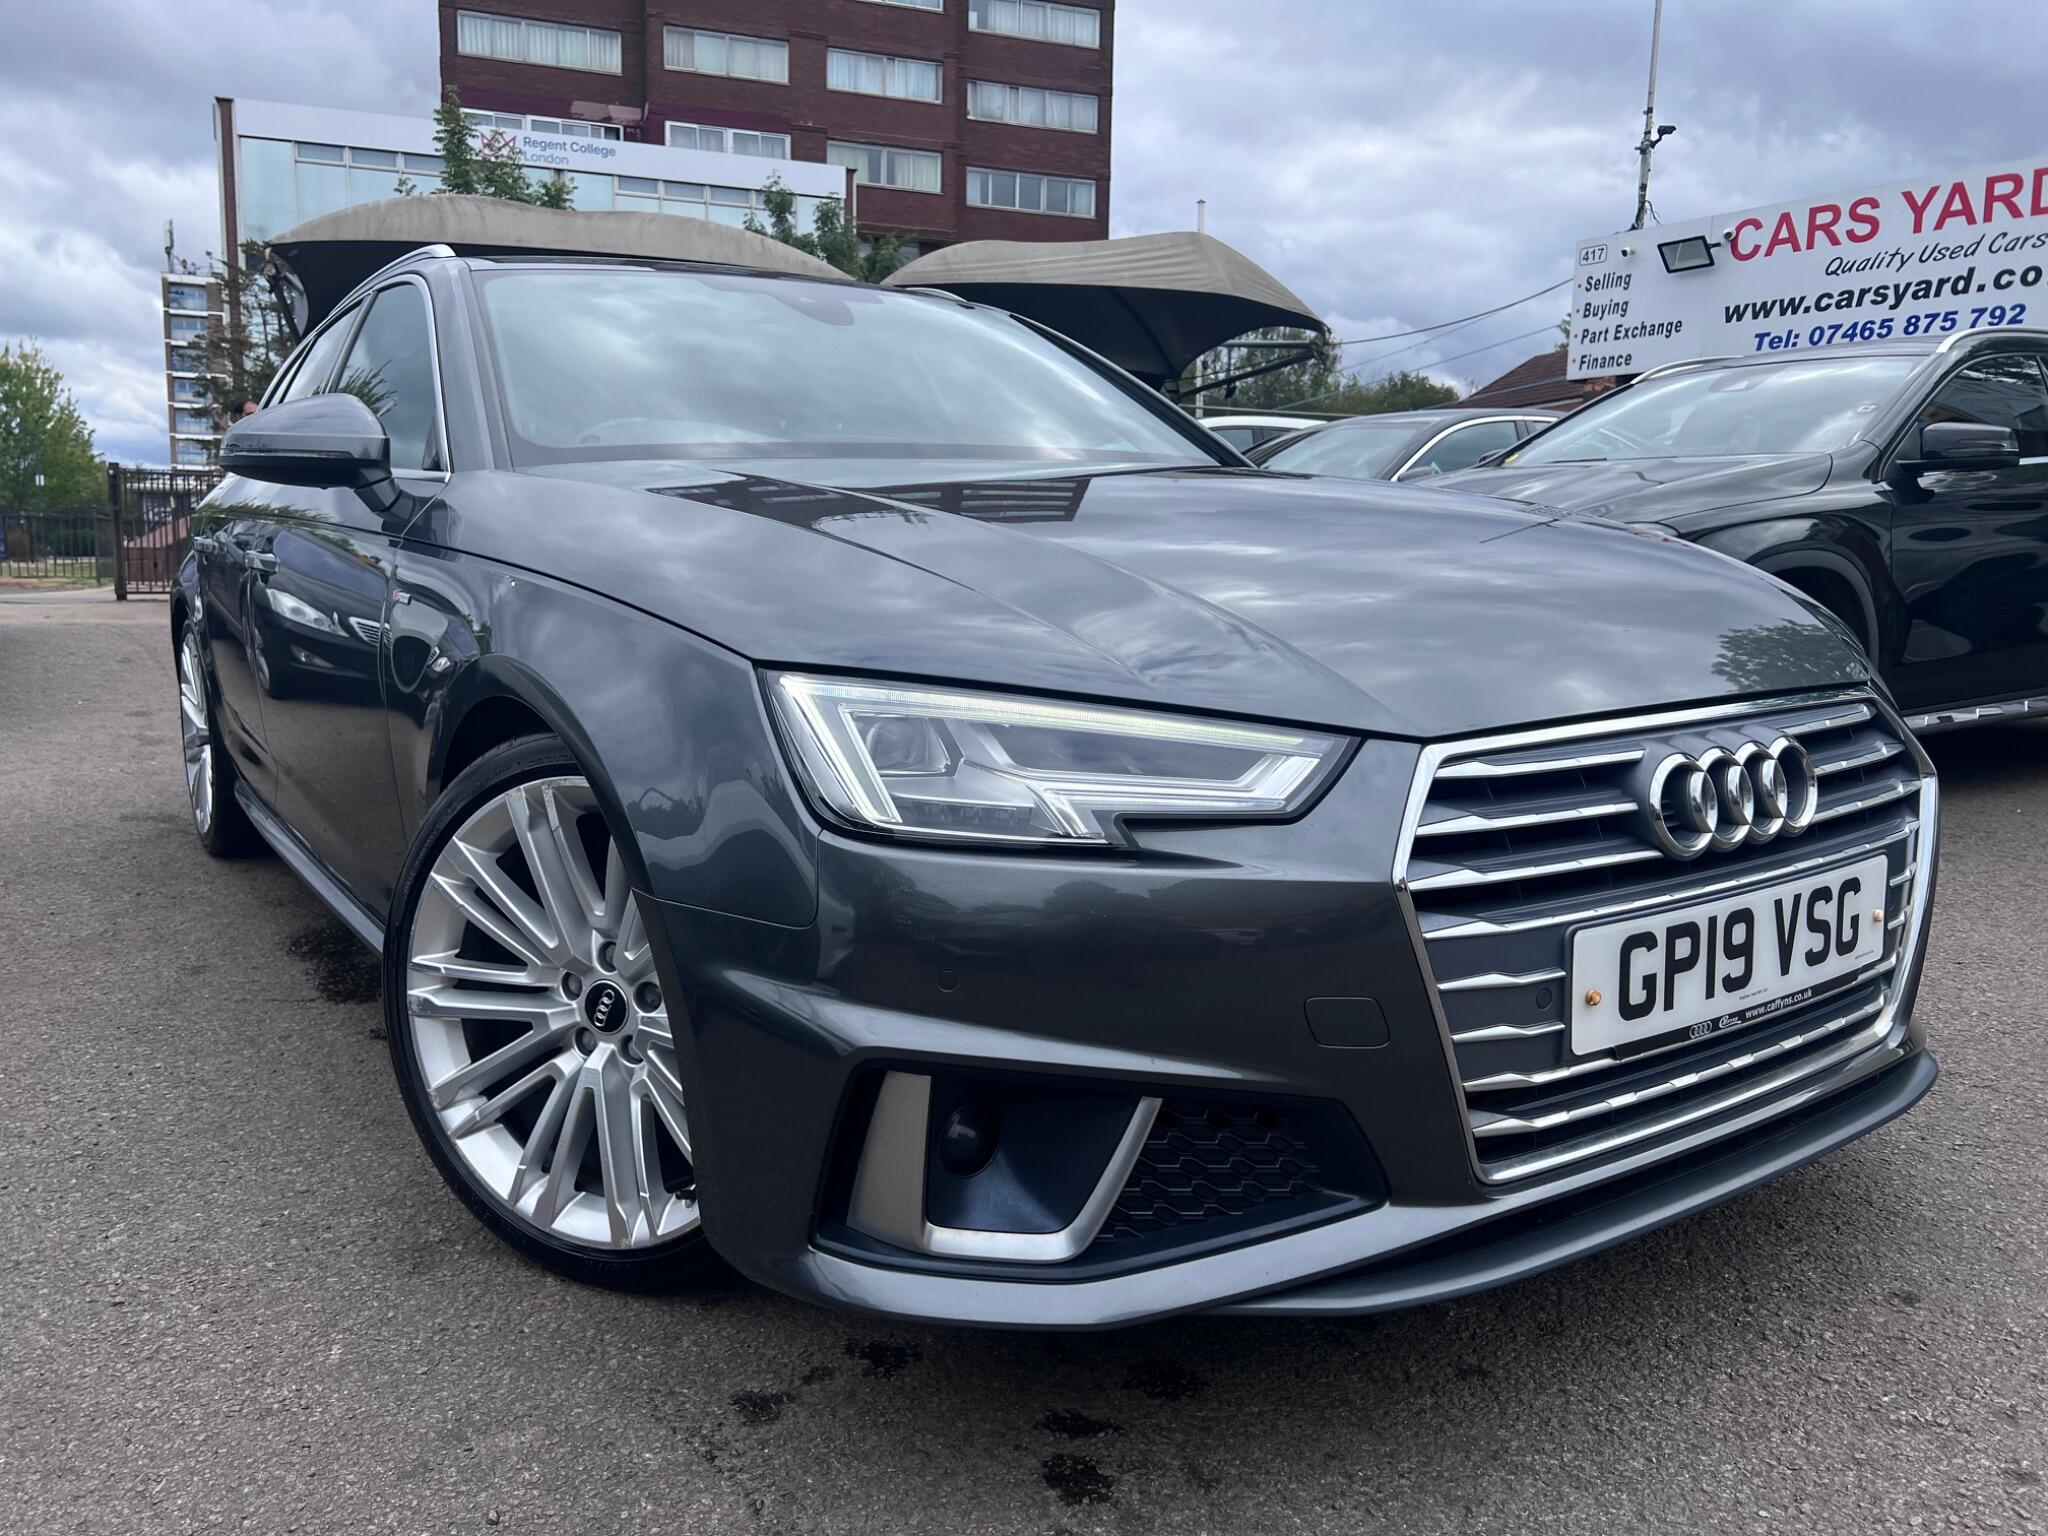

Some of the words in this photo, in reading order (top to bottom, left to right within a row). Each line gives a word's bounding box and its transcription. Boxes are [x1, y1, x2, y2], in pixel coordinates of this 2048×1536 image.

[523, 136, 567, 152] Regent
[570, 141, 616, 158] College
[523, 151, 569, 165] London
[1729, 196, 1881, 262] CARS
[1582, 248, 1605, 262] 417
[1825, 248, 1913, 276] Quality
[1918, 233, 1986, 264] Used
[1585, 272, 1632, 292] Selling
[1724, 265, 2048, 323] www.carsyard.co
[1583, 299, 1629, 320] Buying
[1581, 327, 1609, 345] Part
[1613, 320, 1682, 341] Exchange
[1754, 329, 1800, 352] Tel:
[1808, 317, 1894, 346] 07465
[1903, 309, 1958, 336] 875
[1969, 303, 2027, 330] 792
[1579, 353, 1632, 371] Finance
[1618, 907, 1755, 1022] GP19
[1774, 876, 1861, 976] VSG
[1745, 988, 1813, 1019] www.caffyns.co.uk
